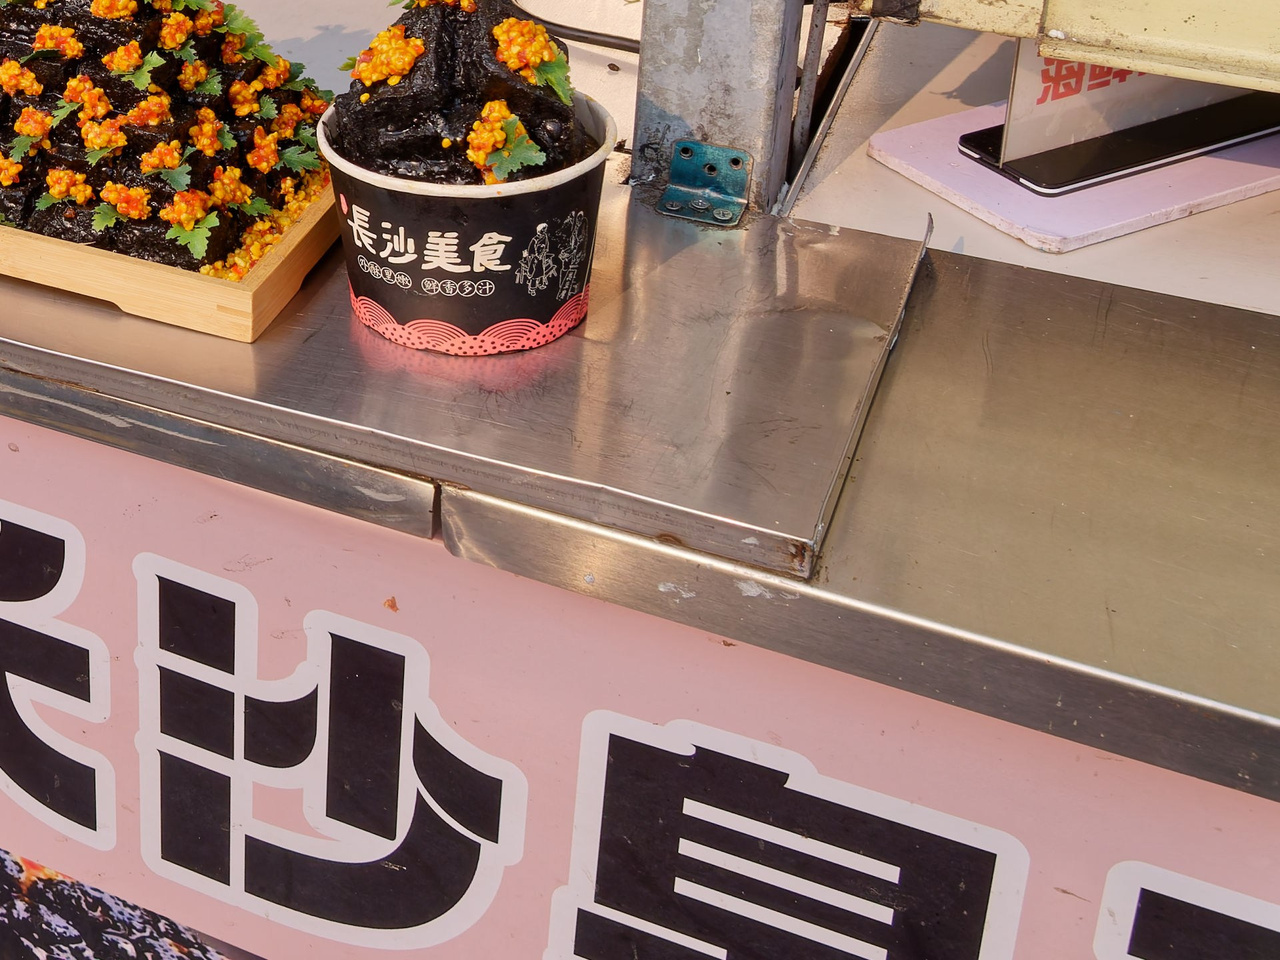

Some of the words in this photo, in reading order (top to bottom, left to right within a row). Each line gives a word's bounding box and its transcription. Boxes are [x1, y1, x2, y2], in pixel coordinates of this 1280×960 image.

[347, 204, 513, 273] 長沙美食
[357, 254, 413, 289] 外酥里嫩
[421, 277, 496, 297] 鲜香多汁
